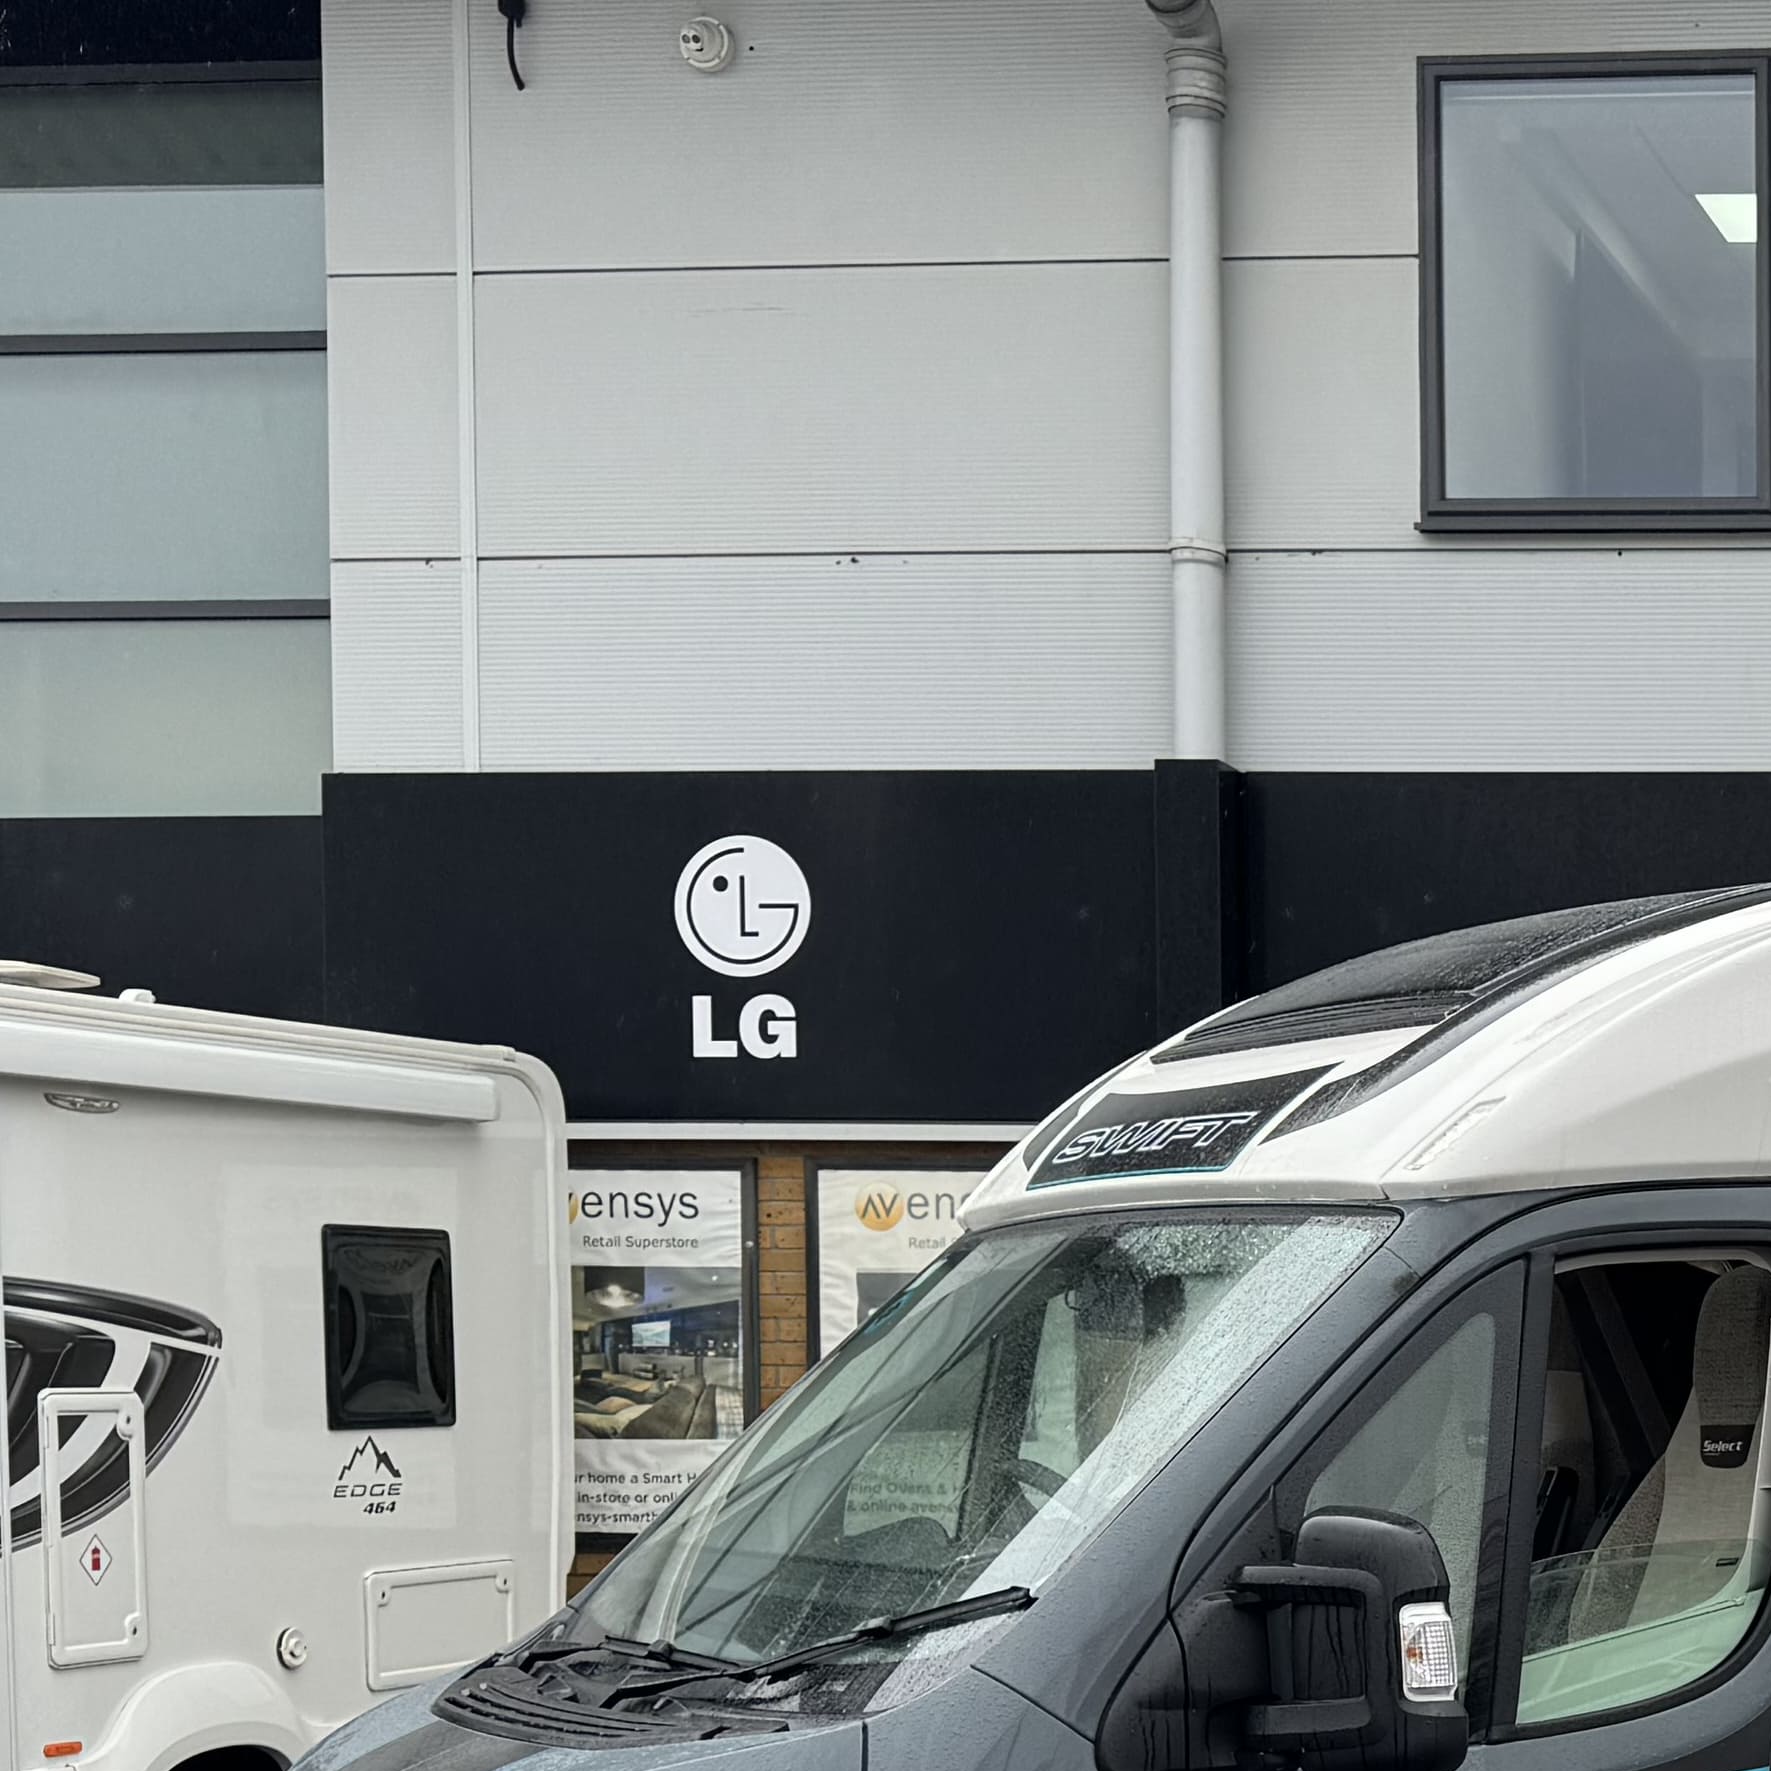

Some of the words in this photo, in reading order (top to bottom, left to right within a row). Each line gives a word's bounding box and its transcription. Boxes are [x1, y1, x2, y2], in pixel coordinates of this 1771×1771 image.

[692, 994, 797, 1060] LG
[1052, 1111, 1262, 1164] SWIFT
[568, 1191, 699, 1228] ensys
[582, 1235, 621, 1248] Retail
[625, 1235, 699, 1250] Superstore
[908, 1236, 946, 1249] Retail
[1702, 1440, 1743, 1452] Select
[588, 1472, 625, 1484] home
[630, 1475, 639, 1484] a
[643, 1472, 682, 1484] Smart
[333, 1483, 403, 1498] EDGE
[577, 1491, 630, 1504] in-store
[634, 1494, 648, 1504] or
[363, 1501, 396, 1514] 464
